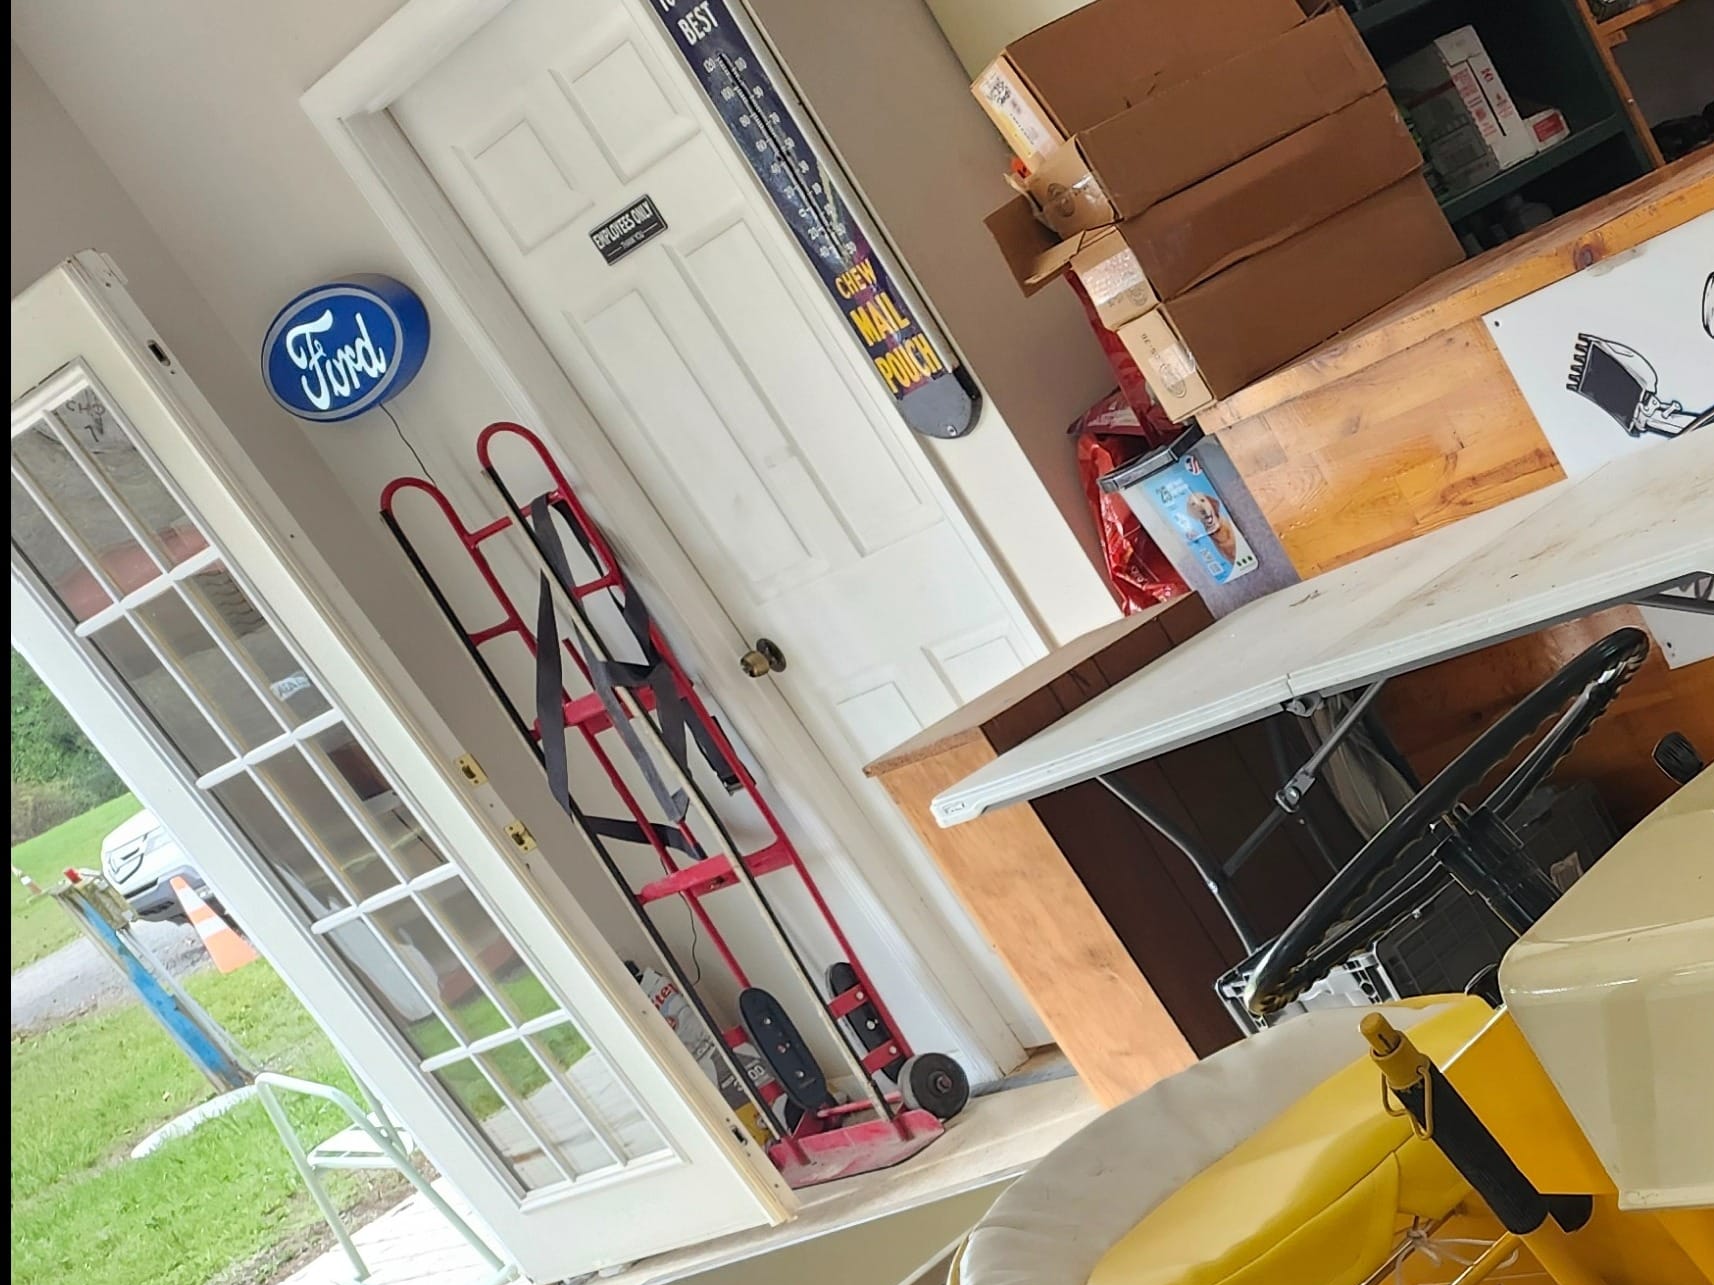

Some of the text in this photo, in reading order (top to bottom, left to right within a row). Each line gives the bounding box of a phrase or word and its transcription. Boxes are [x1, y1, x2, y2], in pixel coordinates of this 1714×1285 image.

[677, 1, 719, 46] BEST
[592, 200, 653, 249] EMPLOYEES ONLY
[835, 258, 877, 299] CHEW
[850, 292, 910, 347] MAIL
[286, 309, 387, 410] Ford
[874, 333, 942, 393] POUCH
